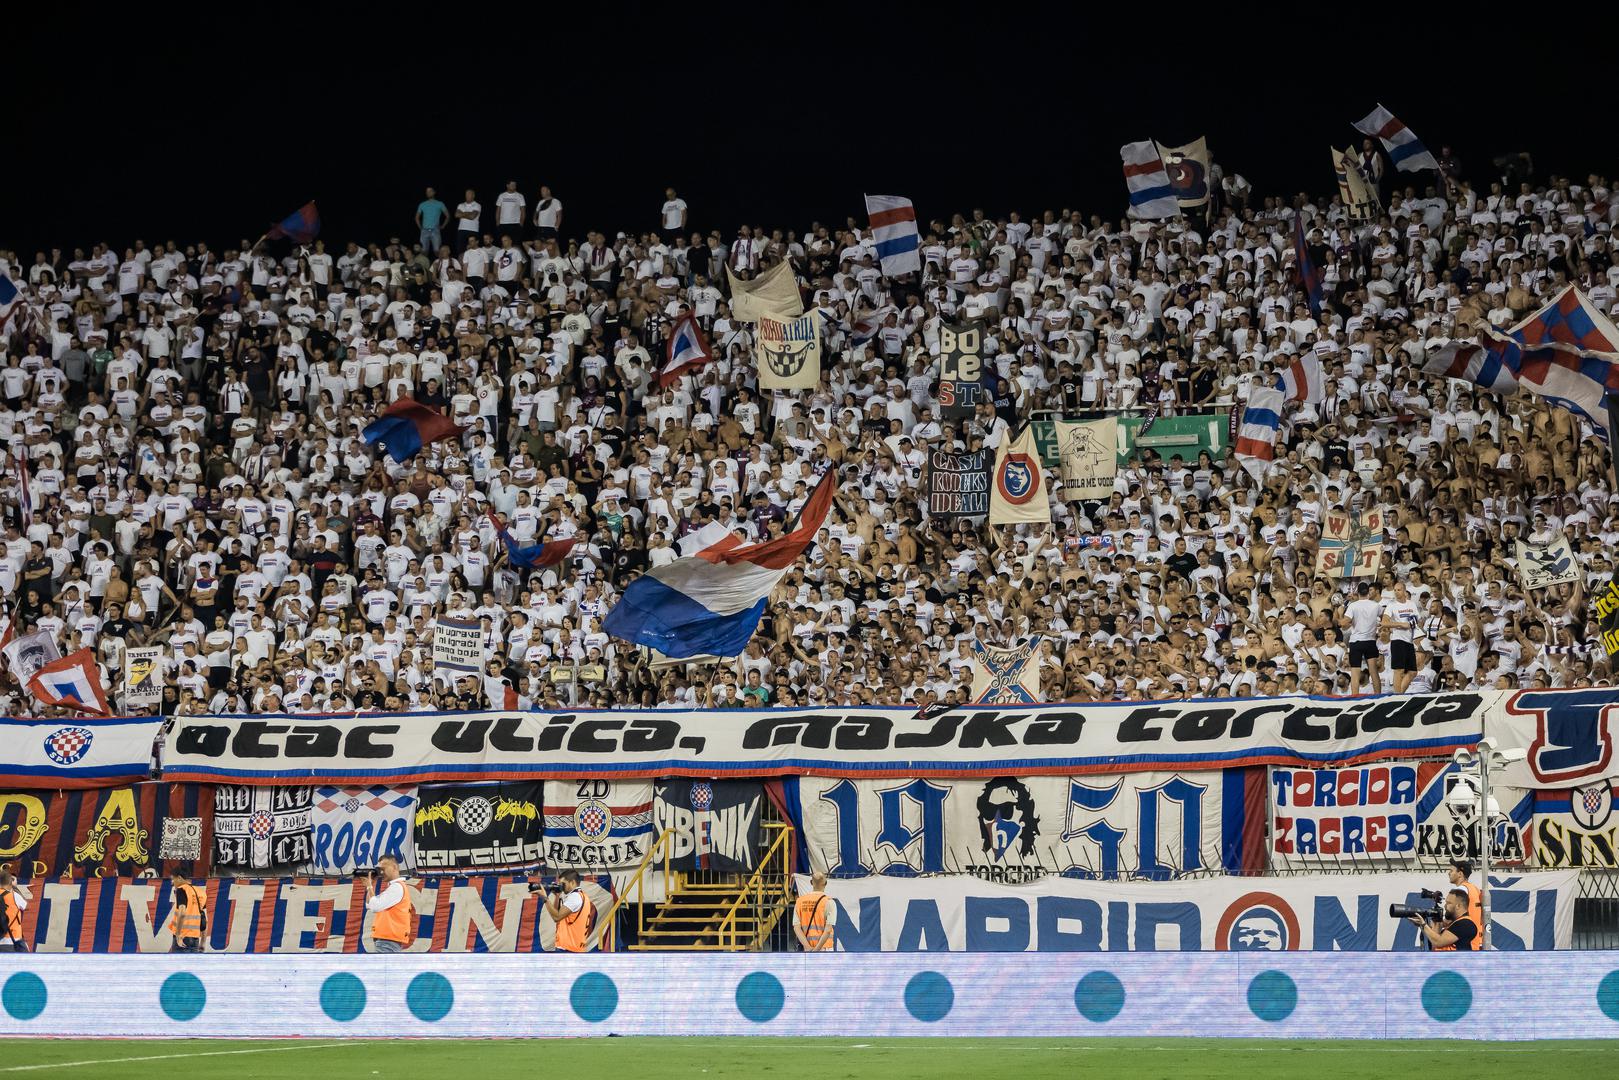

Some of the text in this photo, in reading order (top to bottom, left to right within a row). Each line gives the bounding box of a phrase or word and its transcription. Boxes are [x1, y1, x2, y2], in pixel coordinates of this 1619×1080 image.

[939, 381, 981, 407] ST
[1086, 477, 1097, 488] ME
[53, 727, 93, 738] HAJDUK
[49, 751, 82, 765] SPLIT
[576, 778, 611, 800] ZD
[1272, 765, 1417, 808] TORCIDA
[461, 798, 489, 810] HAJDUK
[463, 823, 486, 833] SPLIT
[653, 785, 761, 871] ŠIBENIK
[1274, 813, 1416, 855] ZAGREB
[547, 840, 643, 865] REGIJA
